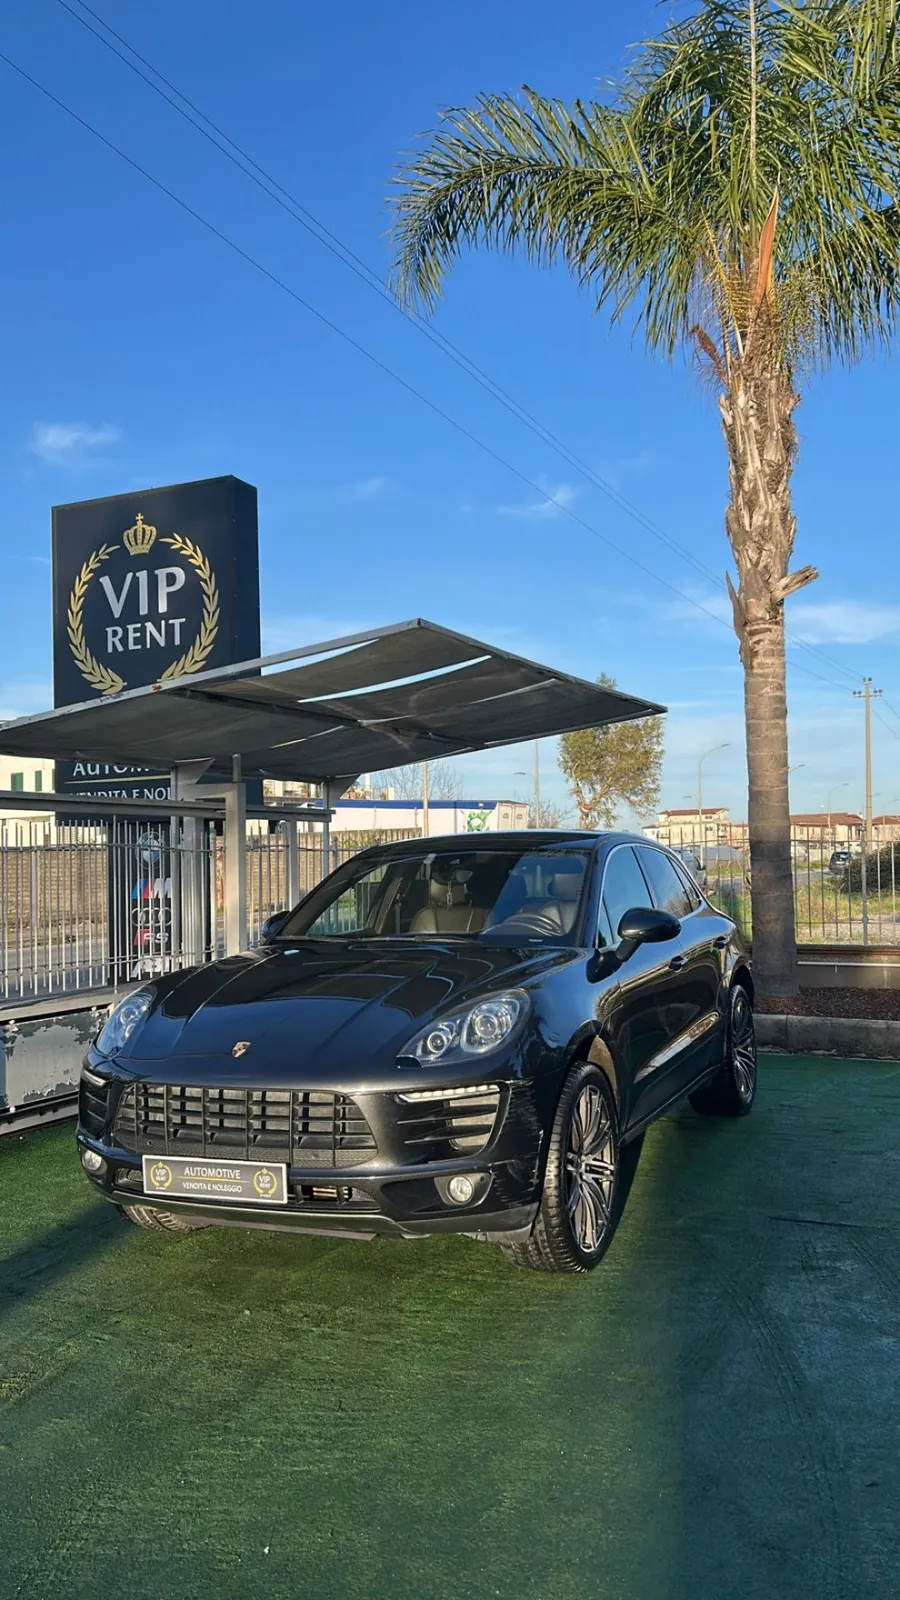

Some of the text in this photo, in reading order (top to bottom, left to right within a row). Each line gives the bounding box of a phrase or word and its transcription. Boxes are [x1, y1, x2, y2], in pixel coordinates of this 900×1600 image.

[99, 566, 186, 618] VIP
[106, 618, 186, 653] RENT
[184, 1166, 241, 1180] AUTOMOTIVE
[258, 1175, 271, 1183] VIP
[182, 1181, 207, 1190] VENDITA
[212, 1183, 243, 1193] NOLEGGIO
